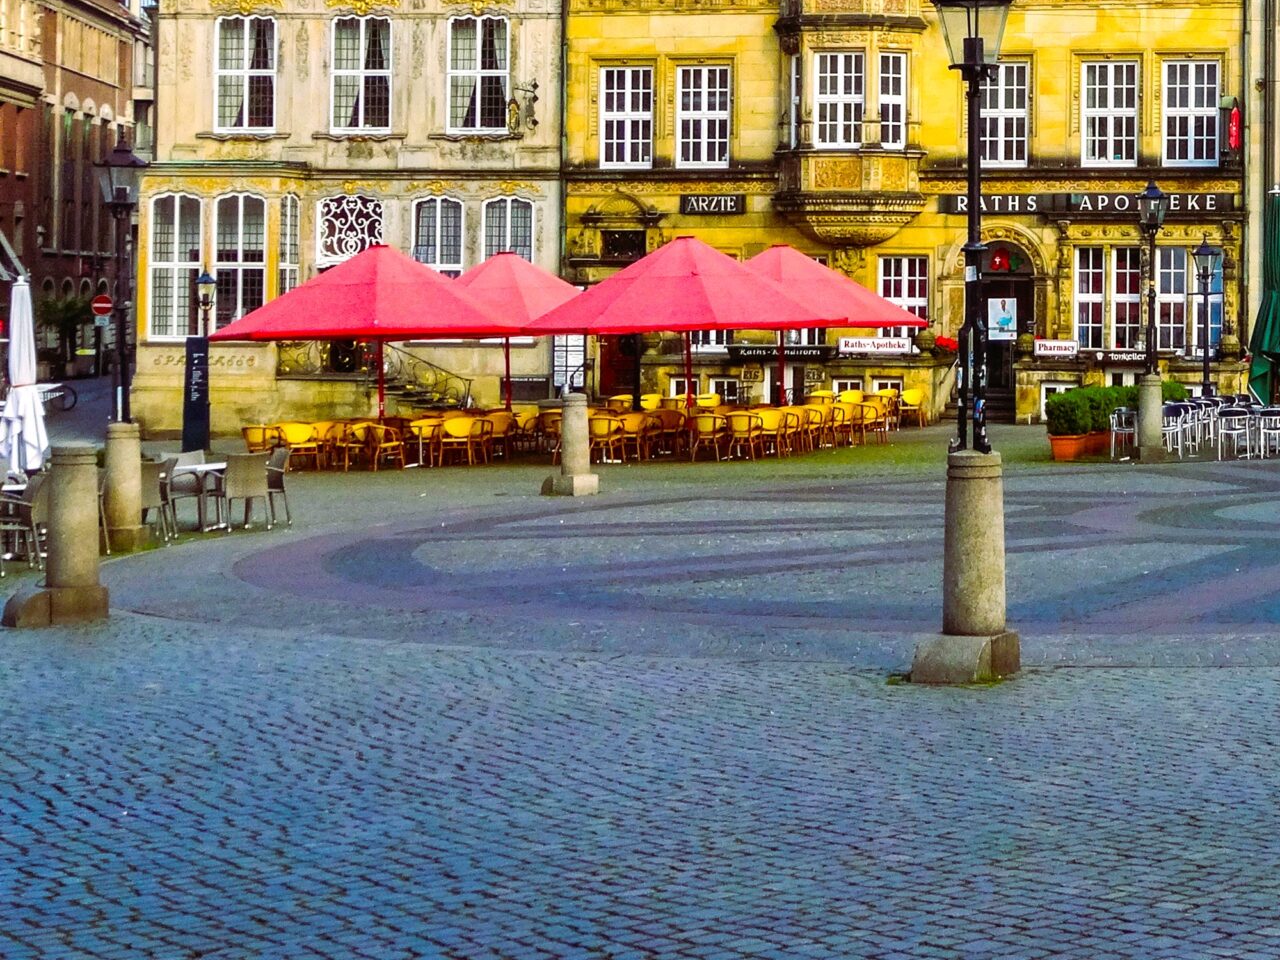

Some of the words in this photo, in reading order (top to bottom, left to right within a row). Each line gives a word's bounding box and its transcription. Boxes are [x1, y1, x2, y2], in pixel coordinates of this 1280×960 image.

[687, 196, 737, 212] ÄRZTE
[957, 195, 1037, 211] RATHS
[844, 340, 906, 350] Raths-Apotheke
[1038, 343, 1075, 352] Pharmacy
[740, 348, 821, 356] Raths-Knditorei
[153, 354, 256, 368] SPAASSE
